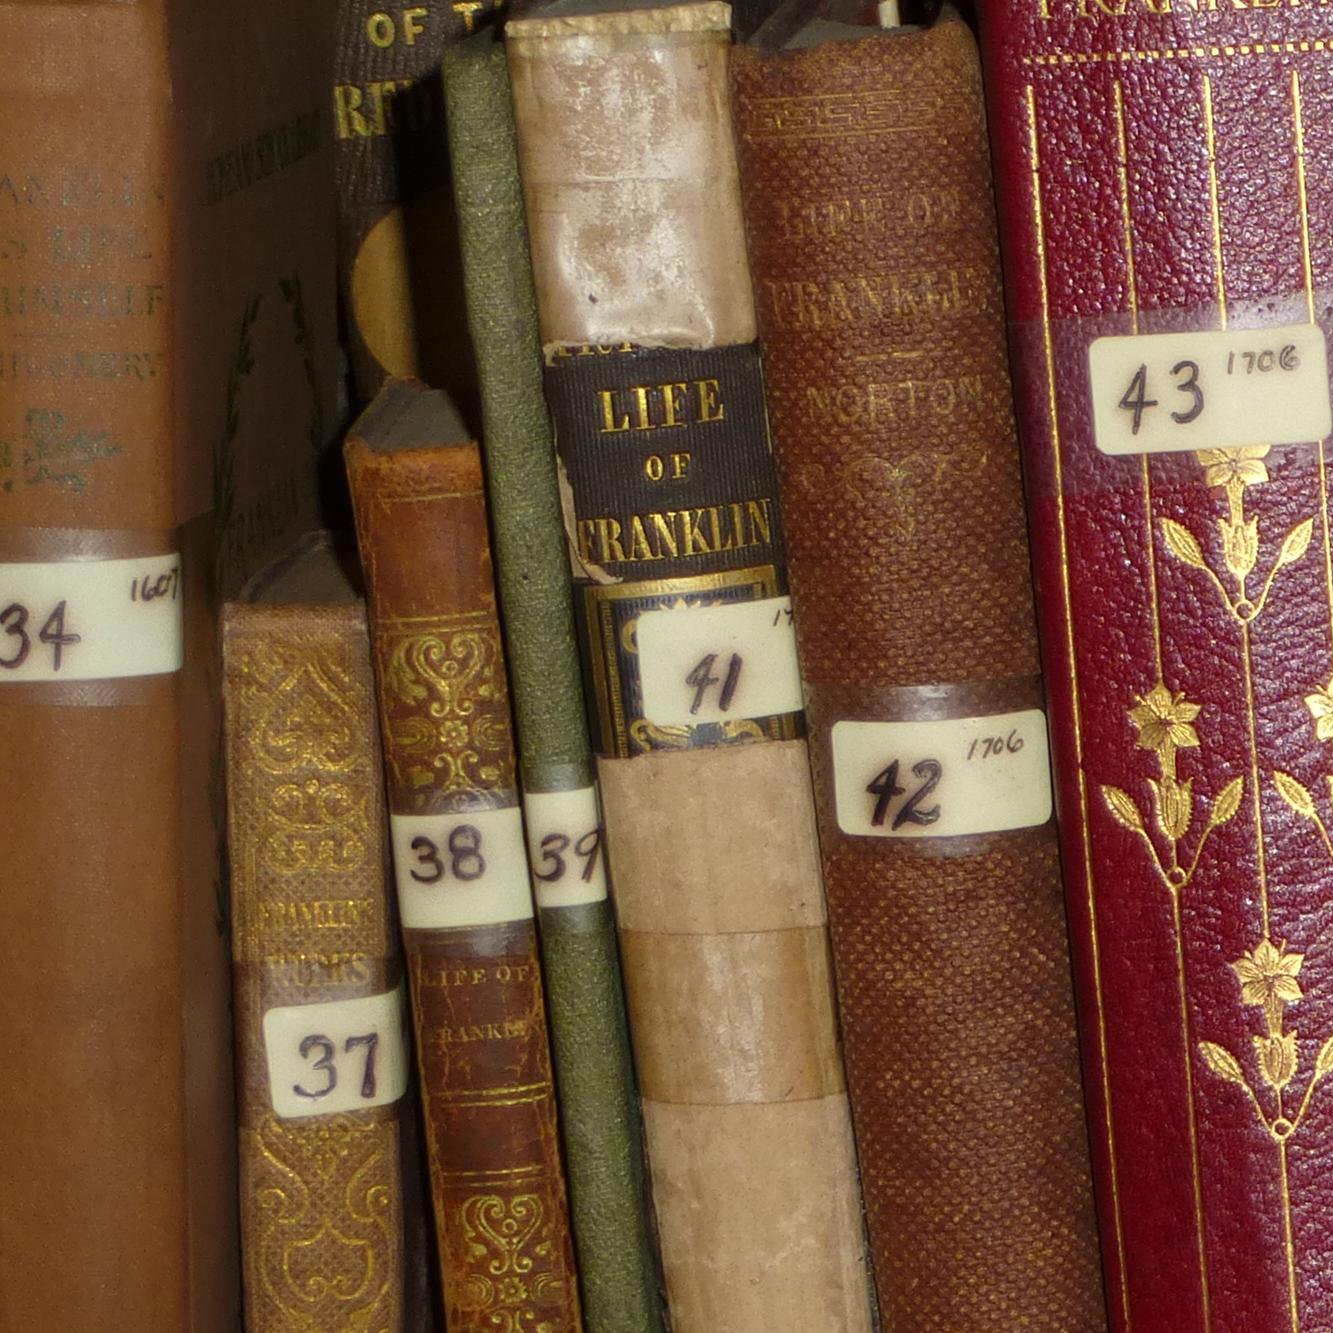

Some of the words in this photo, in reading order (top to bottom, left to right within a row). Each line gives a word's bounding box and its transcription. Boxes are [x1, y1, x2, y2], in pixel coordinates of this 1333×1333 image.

[366, 6, 428, 49] OF
[601, 378, 726, 433] LIFE
[1118, 360, 1205, 436] 43
[1227, 343, 1299, 375] 1706
[645, 451, 692, 482] OF
[578, 498, 772, 565] FRANKLIN
[0, 600, 81, 673] 34
[684, 652, 743, 716] 41
[866, 757, 942, 831] 42
[966, 732, 1025, 761] 1706
[409, 824, 488, 885] 38
[534, 828, 605, 884] 39
[420, 966, 486, 988] LIFE
[495, 963, 532, 983] OF
[292, 1032, 379, 1100] 37
